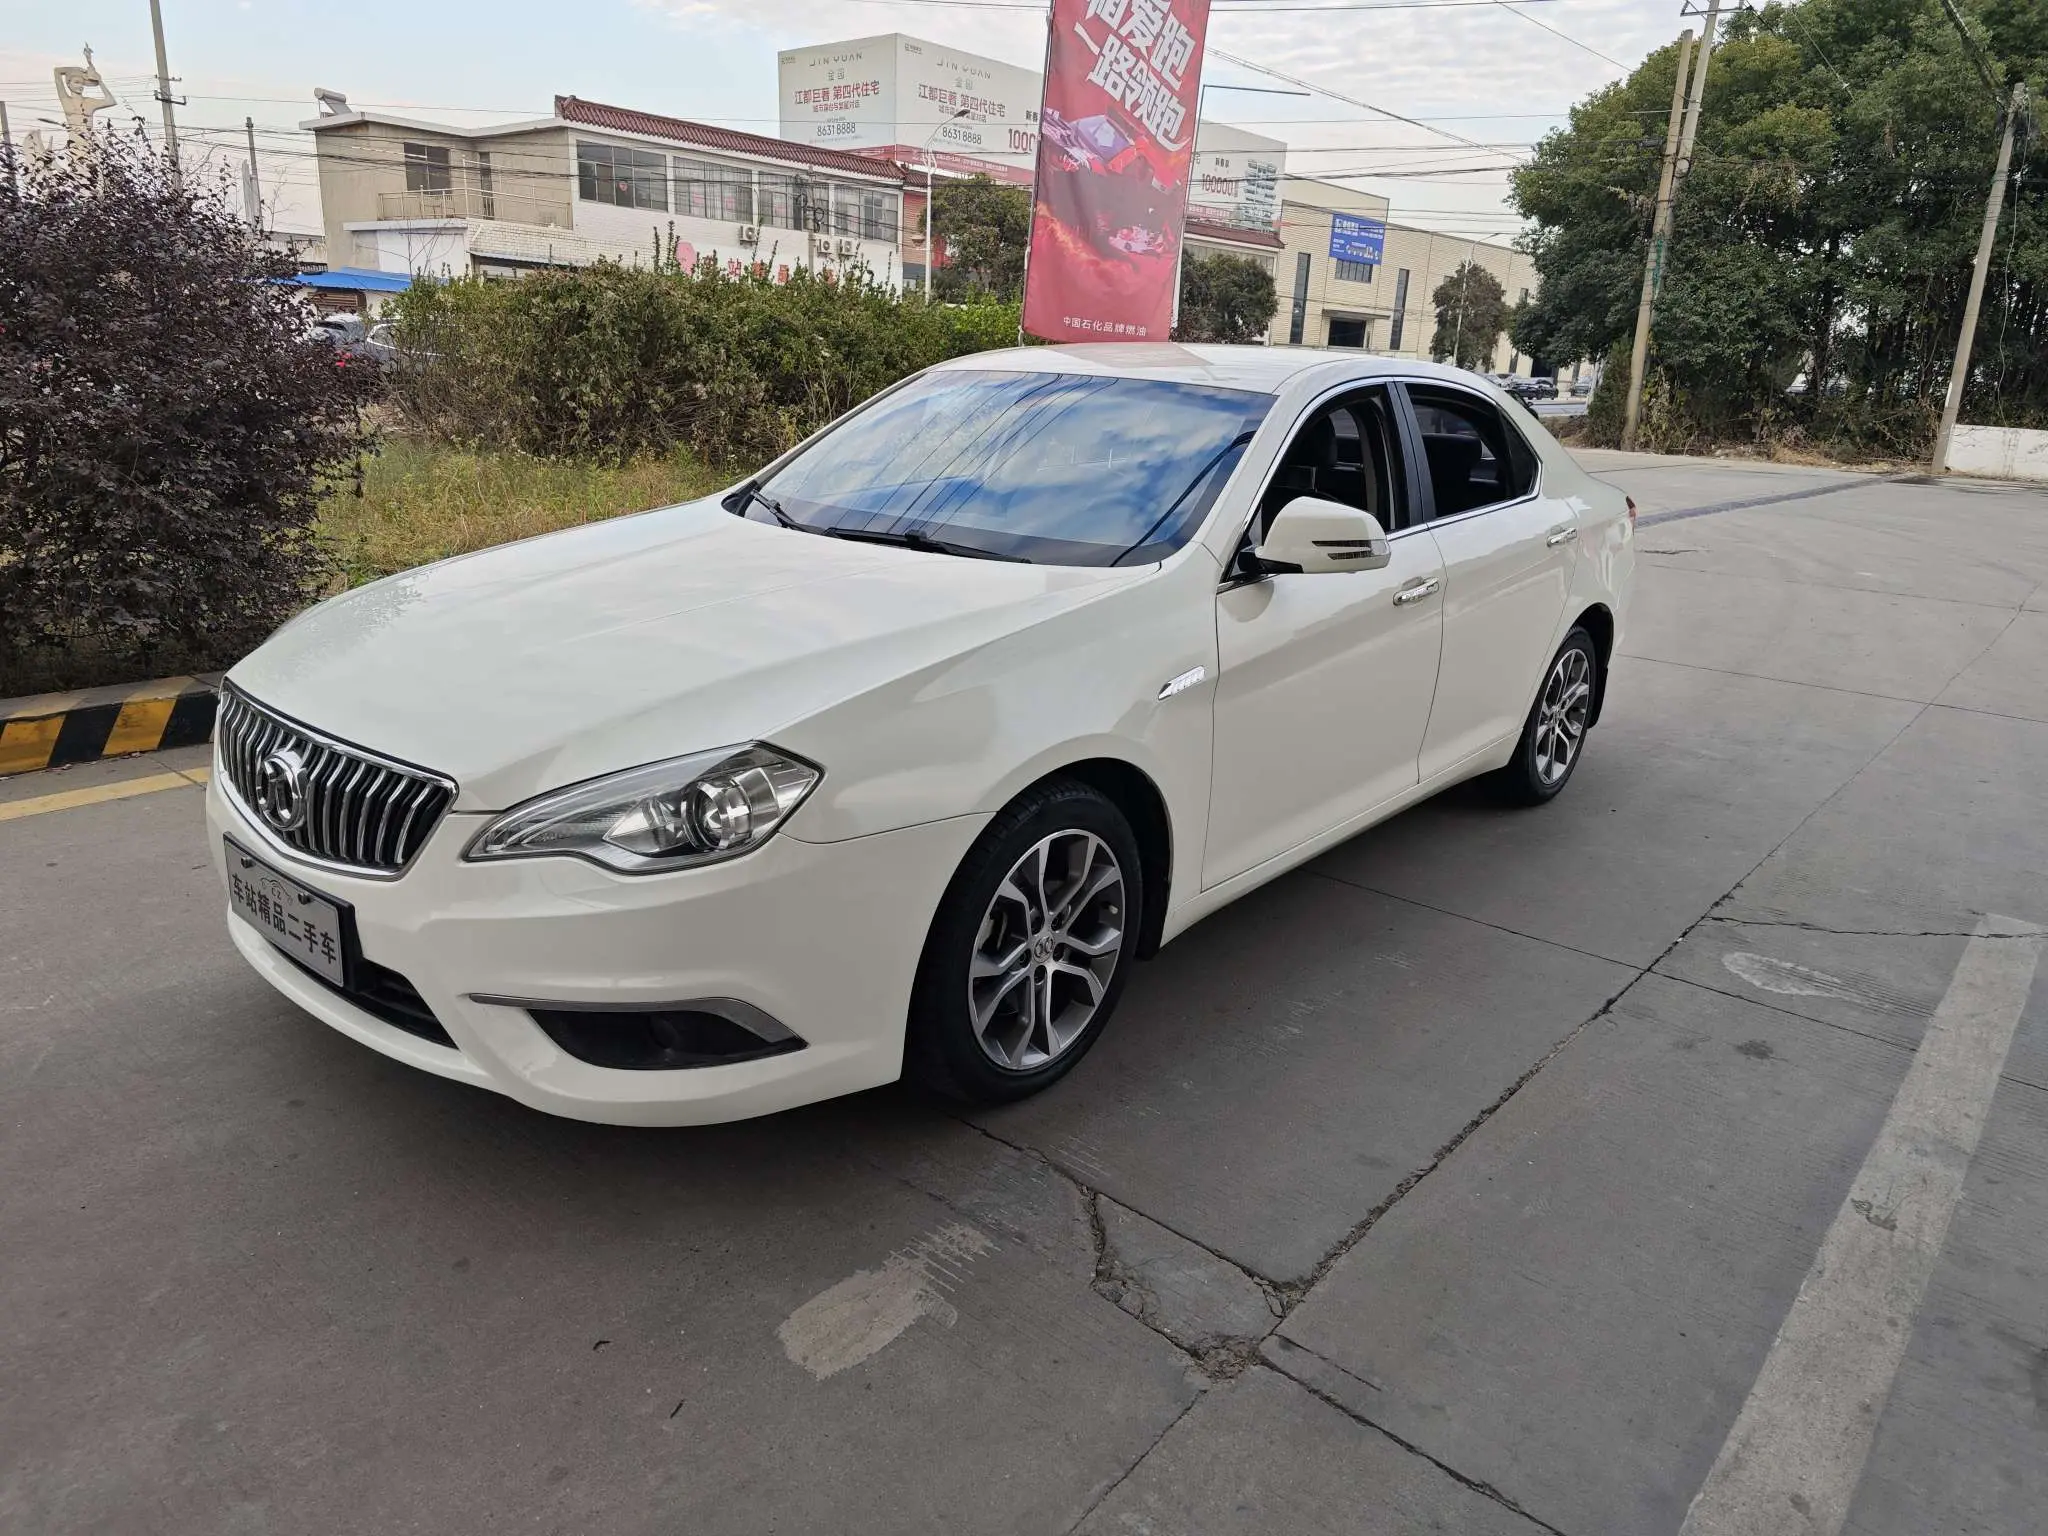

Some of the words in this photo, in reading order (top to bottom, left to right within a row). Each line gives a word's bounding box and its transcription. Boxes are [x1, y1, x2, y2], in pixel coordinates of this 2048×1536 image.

[832, 80, 880, 101] 第四代住宅
[1074, 21, 1191, 151] 一路领跑
[960, 93, 1006, 118] 第四代住宅
[817, 122, 856, 137] 86318888
[942, 126, 982, 145] 86318888
[1063, 316, 1147, 337] 中国石化品牌燃油
[232, 873, 336, 965] 车站精品二手车
